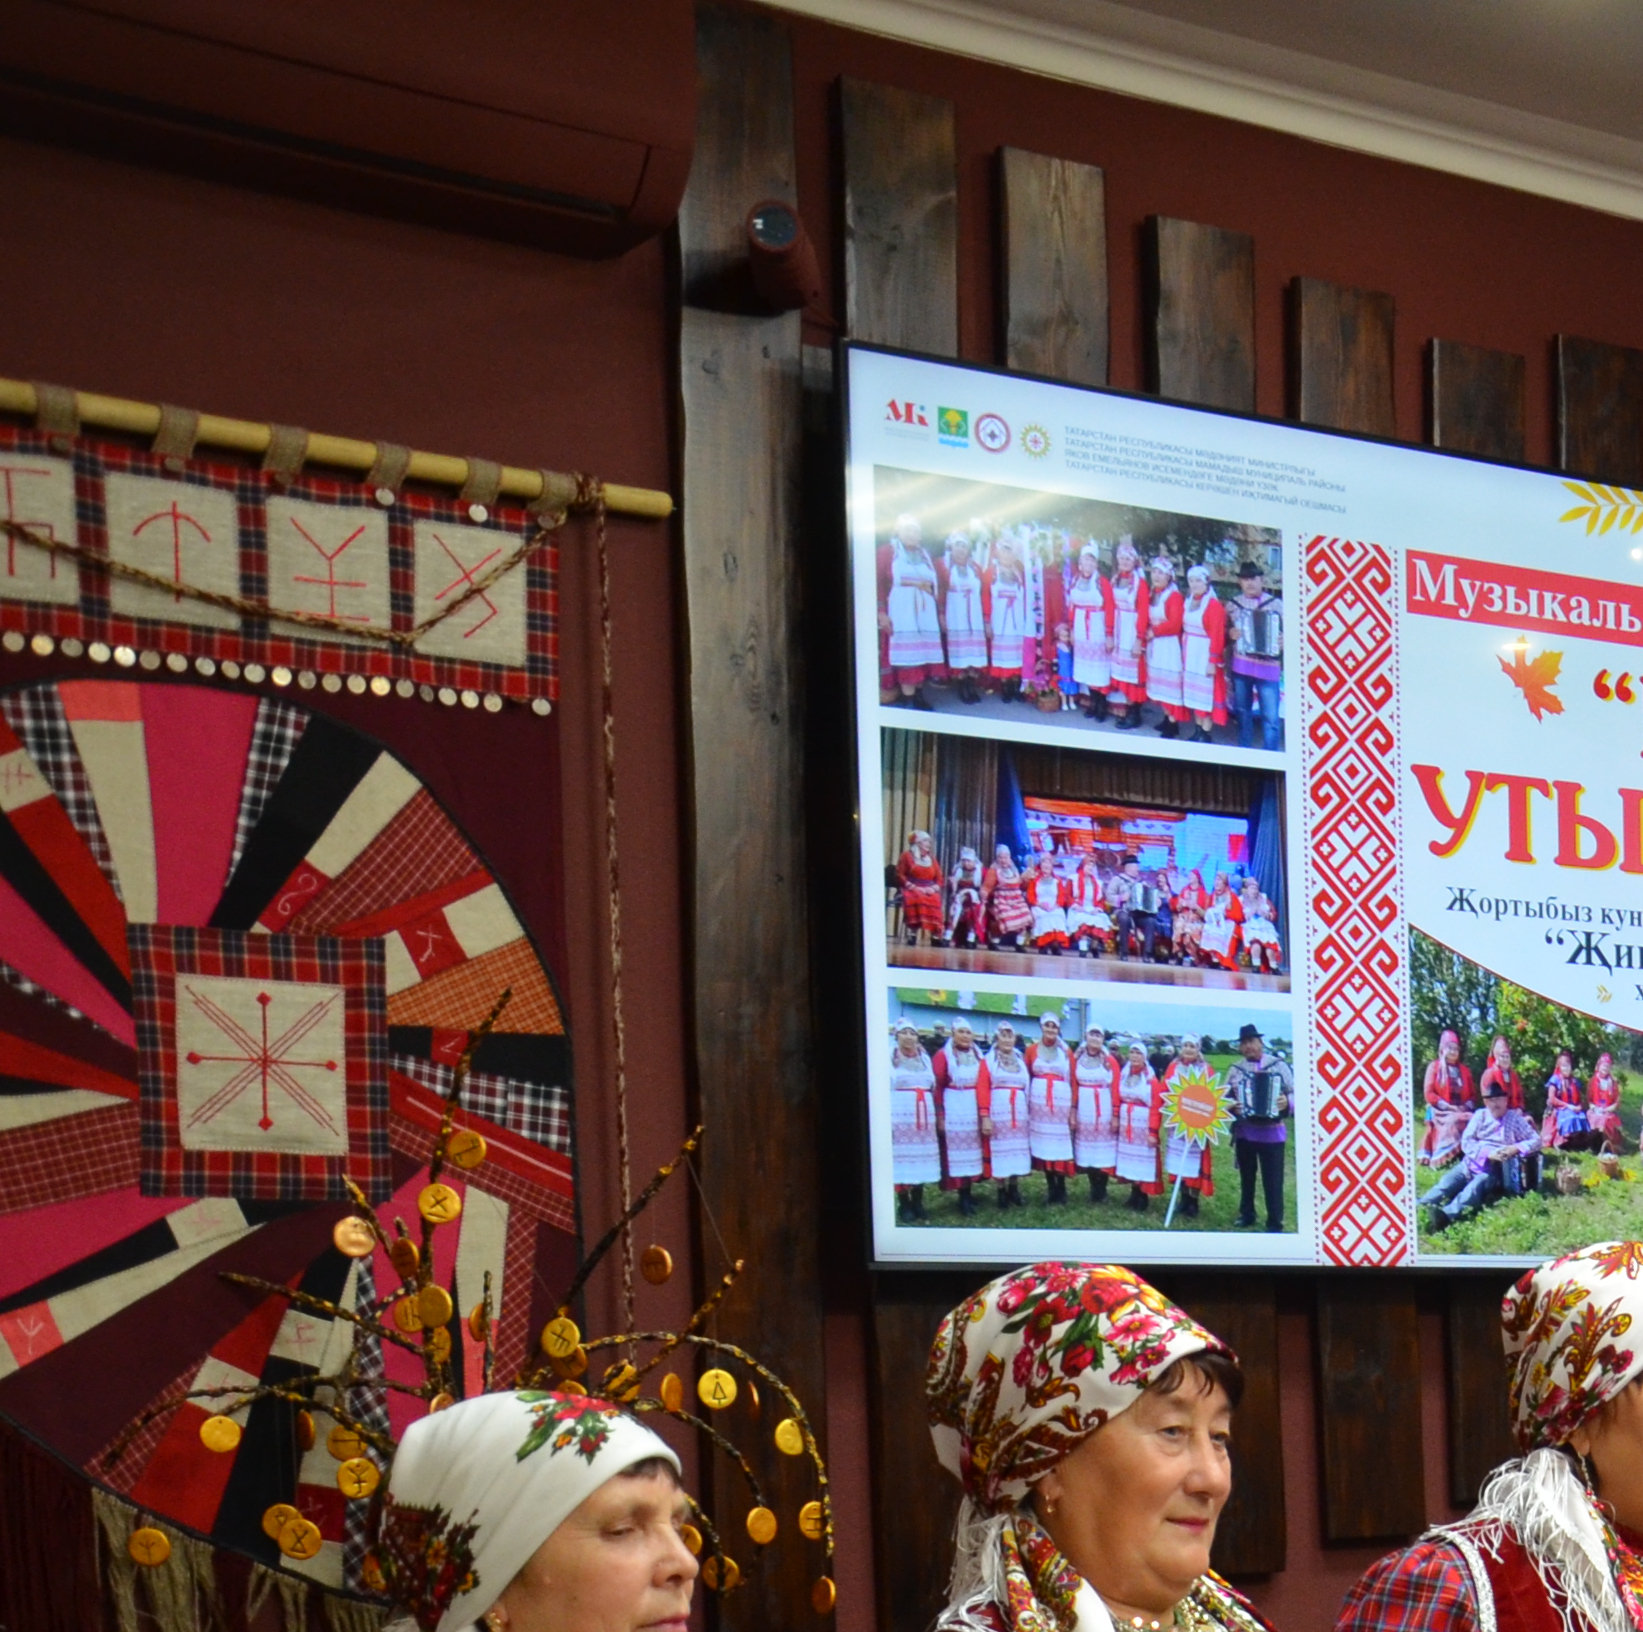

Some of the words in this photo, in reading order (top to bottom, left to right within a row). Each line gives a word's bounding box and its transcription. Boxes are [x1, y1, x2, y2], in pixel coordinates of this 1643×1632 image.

[1065, 426, 1117, 441] ТАТАРСТАН
[1119, 435, 1193, 455] РЕСПУБЛИКАСЫ
[1065, 437, 1117, 453] ТАТАРСТАН
[1119, 446, 1193, 466] РЕСПУБЛИКАСЫ
[1308, 478, 1346, 492] РАЙОНЫ
[1065, 460, 1117, 475] ТАТАРСТАН
[1119, 469, 1193, 489] РЕСПУБЛИКАСЫ
[1411, 557, 1642, 632] Музыкаль
[1445, 886, 1593, 926] Җортыбыз
